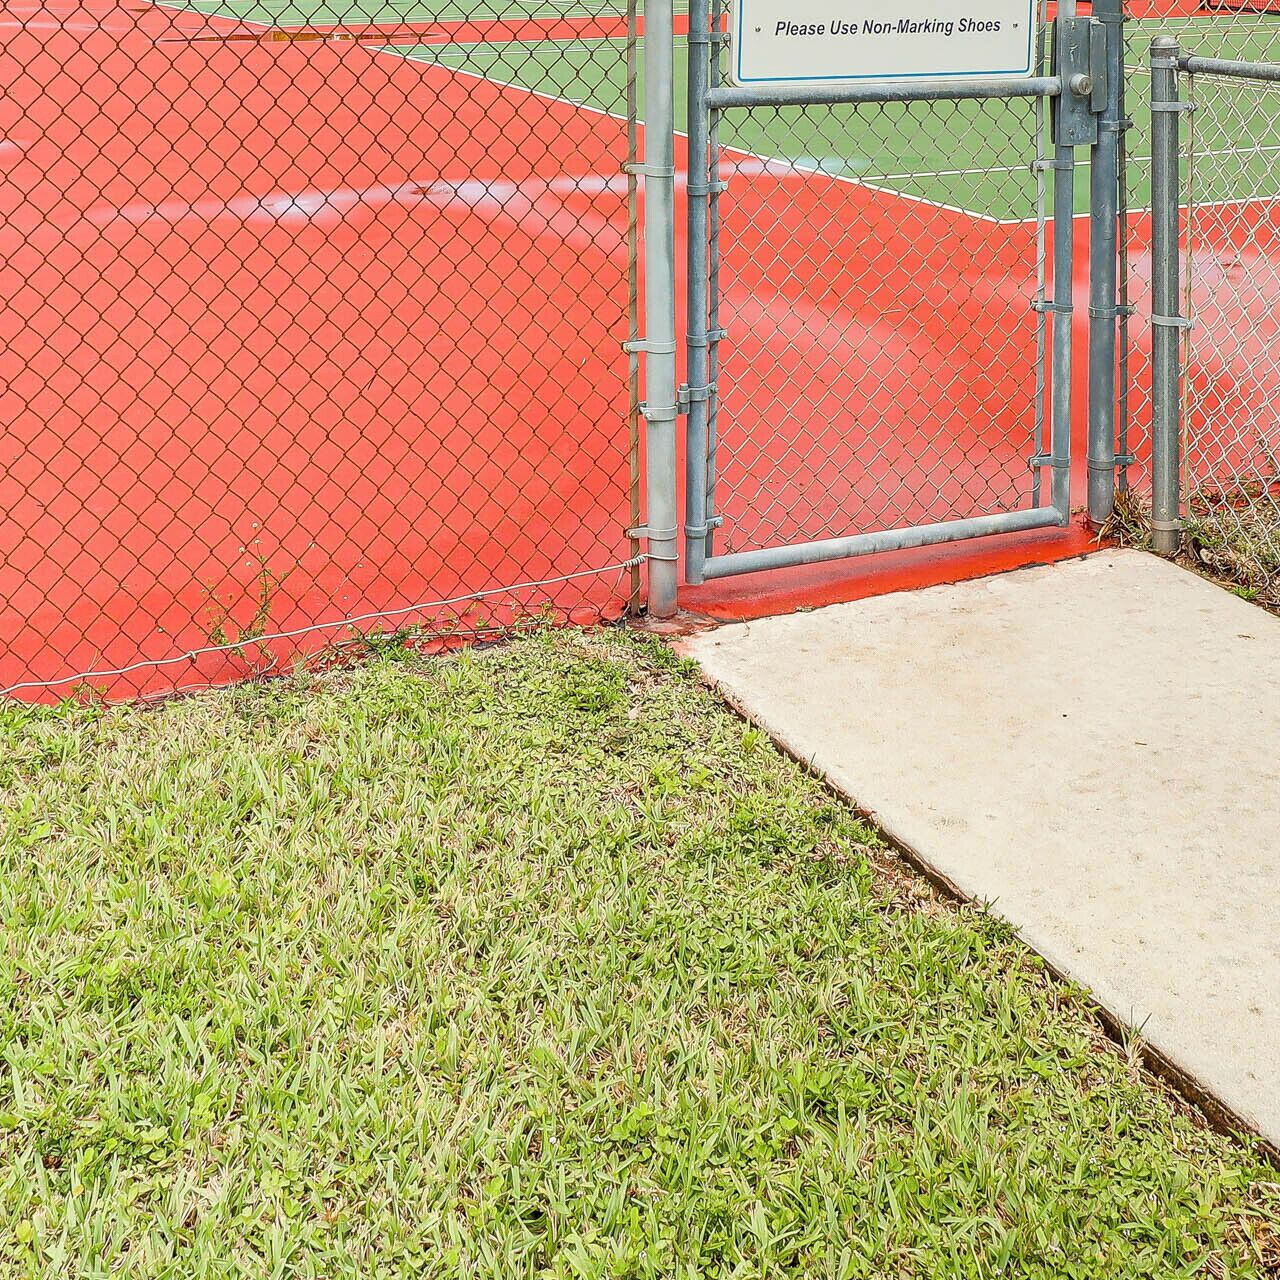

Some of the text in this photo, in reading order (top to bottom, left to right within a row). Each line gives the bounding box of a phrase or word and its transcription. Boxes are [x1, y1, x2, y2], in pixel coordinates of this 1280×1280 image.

[774, 17, 1001, 37] Please Use Non-Marking Shoes
